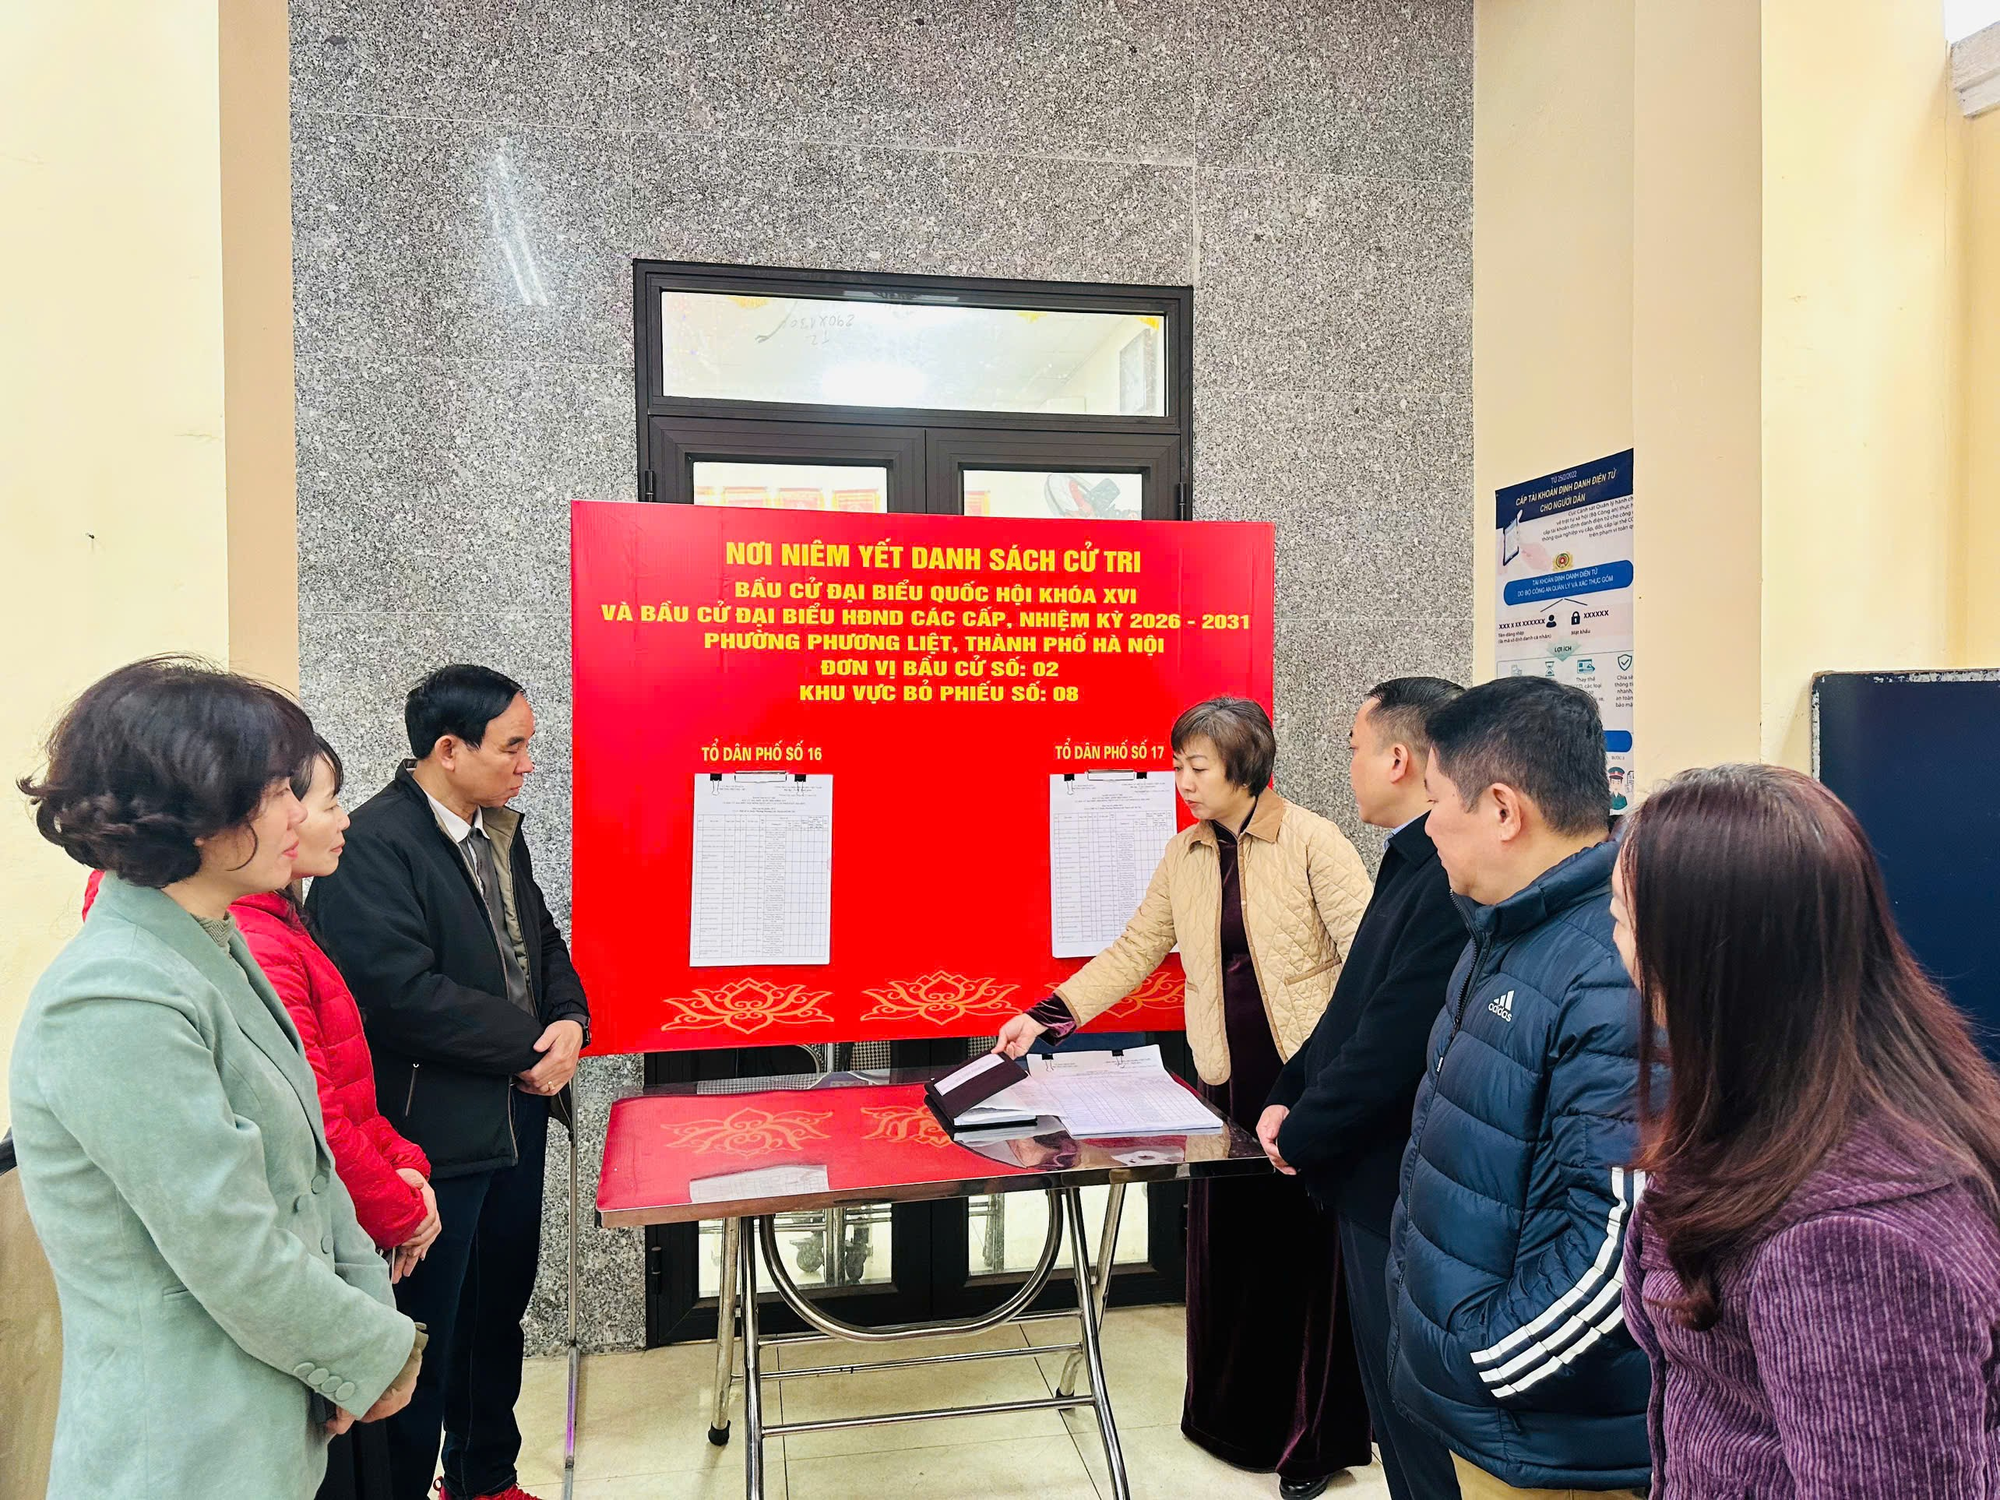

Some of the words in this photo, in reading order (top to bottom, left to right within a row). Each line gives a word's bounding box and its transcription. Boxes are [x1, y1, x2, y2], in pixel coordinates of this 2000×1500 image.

[1515, 494, 1527, 506] CẤP
[1529, 491, 1537, 502] TÀI
[1538, 486, 1558, 500] KHOẢN
[1558, 483, 1573, 495] ĐỊNH
[1573, 478, 1591, 490] DANH
[1592, 473, 1606, 485] ĐIỆN
[1607, 467, 1617, 480] TỬ
[1540, 502, 1552, 512] CHO
[1553, 495, 1572, 509] NGƯỜI
[1573, 492, 1586, 504] DÂN
[726, 541, 772, 565] NƠI
[782, 539, 849, 567] NIÊM
[859, 538, 903, 569] YẾT
[912, 547, 981, 570] DANH
[990, 544, 1055, 572] SÁCH
[1063, 541, 1099, 572] CỬ
[1104, 551, 1140, 572] TRI
[735, 577, 781, 599] BẦU
[790, 576, 823, 599] CỬ
[827, 584, 864, 602] ĐẠI
[872, 579, 923, 600] BIỂU
[931, 580, 988, 603] QUỐC
[996, 584, 1031, 605] HỘI
[1039, 585, 1096, 603] KHÓA
[1103, 589, 1136, 604] XVI
[601, 601, 632, 622] VÀ
[641, 600, 688, 622] BẦU
[697, 600, 730, 623] CỬ
[736, 608, 774, 627] ĐẠI
[783, 602, 834, 625] BIỂU
[842, 610, 903, 626] HĐND
[911, 608, 955, 626] CÁC
[962, 606, 1012, 629] CẤP,
[1020, 609, 1089, 631] NHIỆM
[1097, 611, 1123, 628] KỲ
[1130, 614, 1180, 629] 2026
[1202, 614, 1249, 629] 2031
[1583, 610, 1609, 619] XXXXXX
[704, 630, 800, 649] PHƯỜNG
[808, 634, 900, 650] PHƯƠNG
[908, 633, 959, 653] LIỆT,
[965, 635, 1036, 652] THÀNH
[1044, 632, 1086, 652] PHỐ
[1093, 635, 1121, 652] HÀ
[1128, 637, 1164, 656] NỘI
[821, 658, 868, 675] ĐƠN
[876, 660, 895, 679] VỊ
[903, 655, 947, 676] BẦU
[955, 655, 986, 676] CỬ
[991, 656, 1026, 677] SỐ:
[1033, 661, 1059, 677] 02
[800, 685, 845, 701] KHU
[852, 684, 895, 704] VỰC
[903, 679, 932, 701] BỎ
[941, 681, 1003, 701] PHIẾU
[1012, 681, 1046, 701] SỐ:
[1053, 686, 1078, 701] 08
[702, 739, 719, 761] TỔ
[723, 743, 751, 761] DÂN
[756, 740, 782, 761] PHỐ
[786, 740, 803, 761] SỐ
[808, 747, 822, 760] 16
[1055, 739, 1071, 759] TỔ
[1075, 742, 1100, 759] DÂN
[1104, 739, 1128, 759] PHỐ
[1131, 739, 1147, 759] SỐ
[1152, 746, 1164, 759] 17
